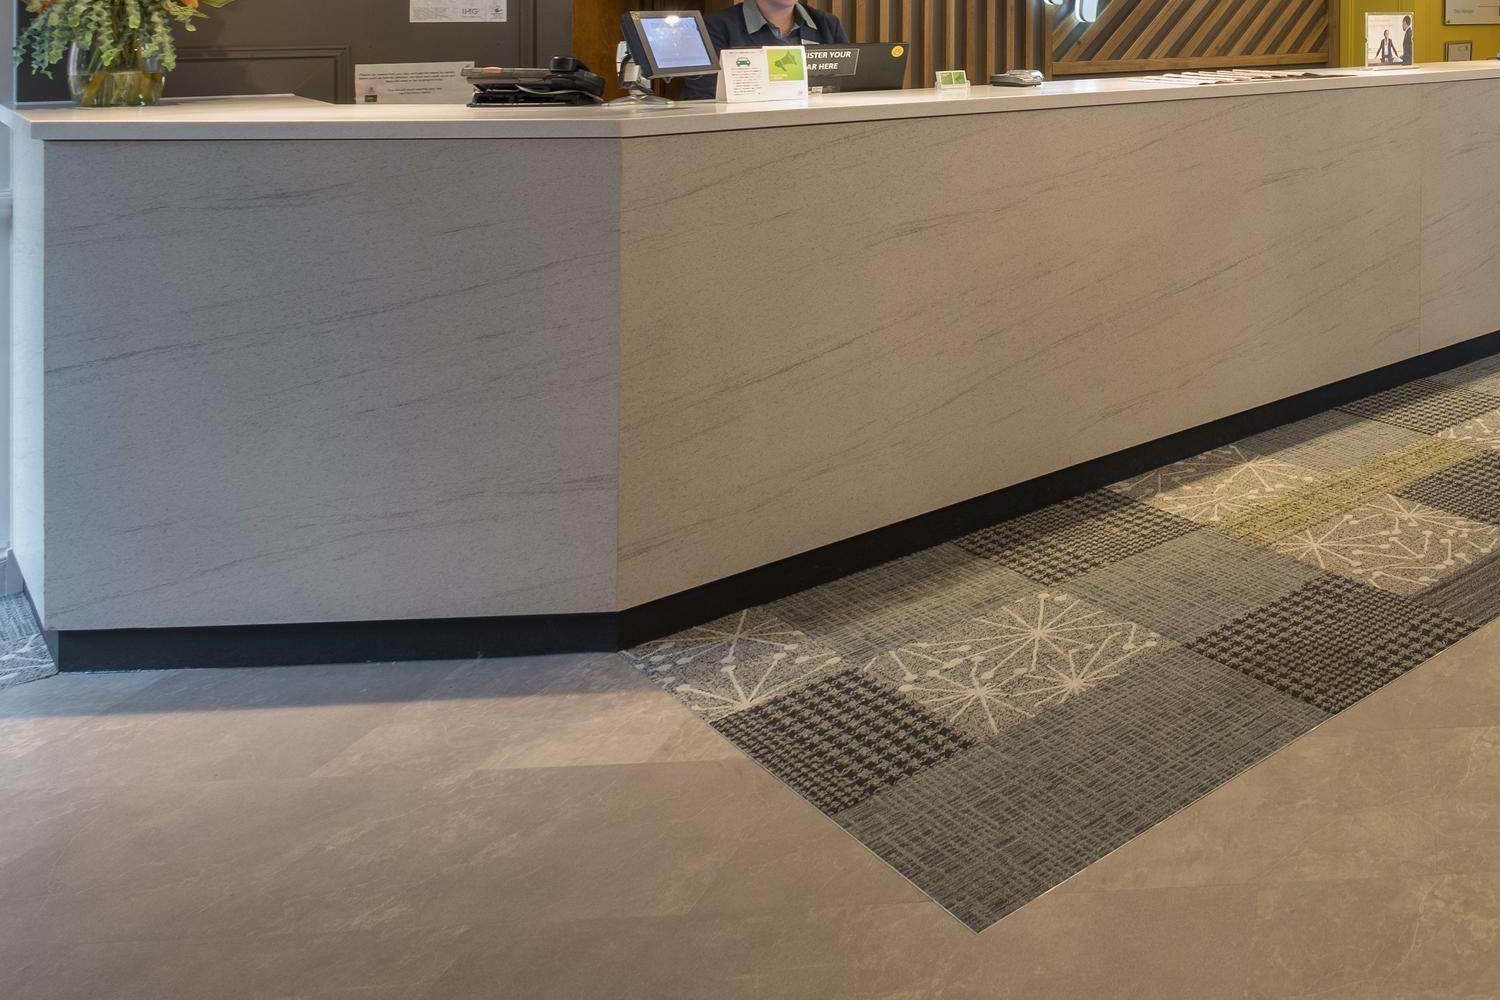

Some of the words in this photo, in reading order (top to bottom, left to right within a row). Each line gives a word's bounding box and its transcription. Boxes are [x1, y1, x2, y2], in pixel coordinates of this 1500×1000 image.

[807, 51, 828, 59] ISTER
[807, 63, 818, 71] AR
[818, 62, 839, 70] HERE
